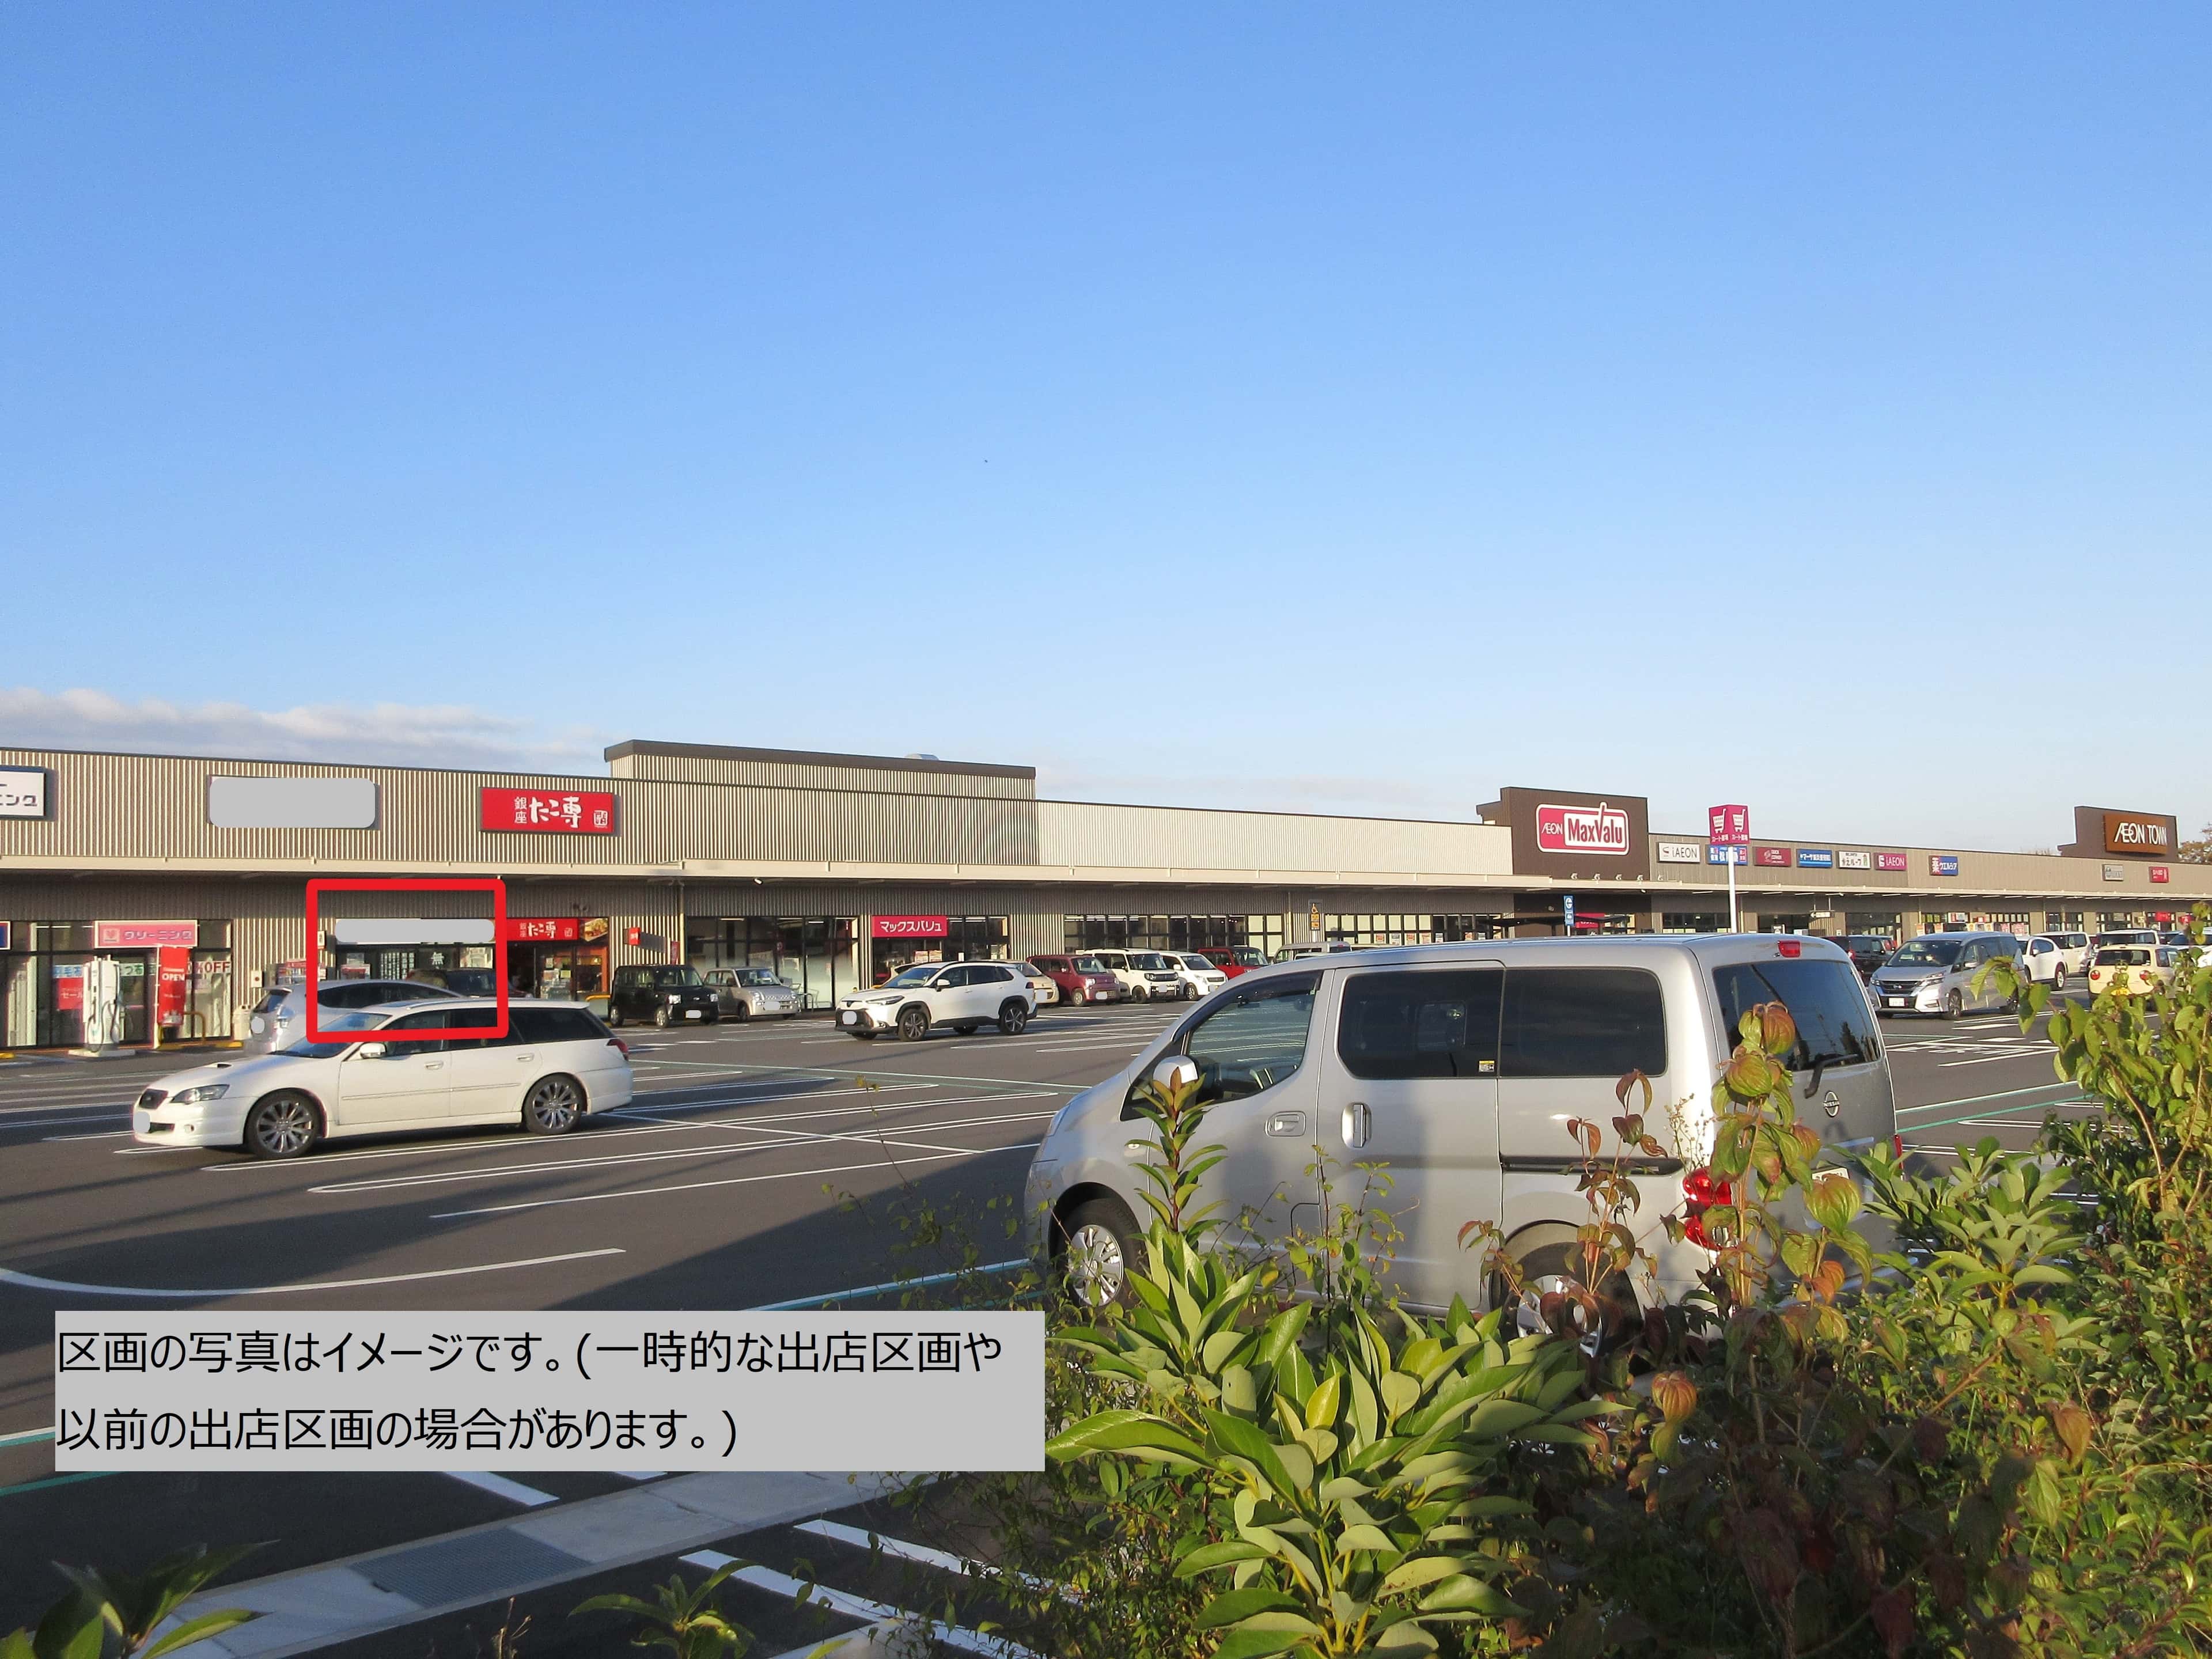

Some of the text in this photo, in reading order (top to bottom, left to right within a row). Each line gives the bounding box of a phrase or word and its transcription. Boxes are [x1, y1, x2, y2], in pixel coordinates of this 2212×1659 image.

[514, 797, 527, 824] 銀座
[1567, 805, 1623, 844] MaxValu
[2146, 824, 2167, 846] TOWN
[1672, 847, 1697, 858] iAEON
[880, 921, 942, 933] マックスバリュ
[161, 973, 185, 982] OPEN
